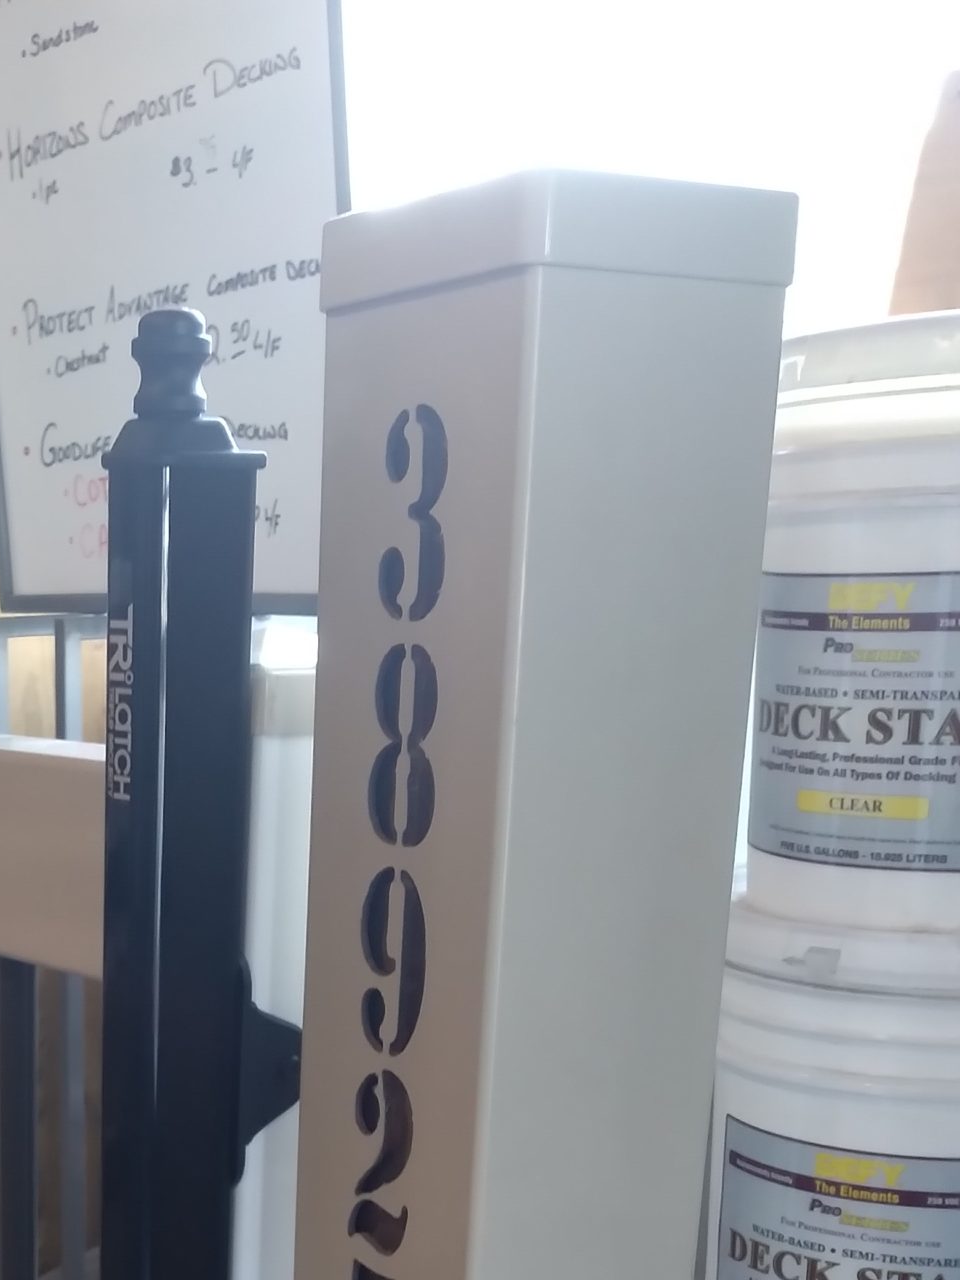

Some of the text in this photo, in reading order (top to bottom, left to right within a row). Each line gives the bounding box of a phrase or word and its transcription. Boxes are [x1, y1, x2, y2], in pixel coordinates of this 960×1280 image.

[22, 298, 96, 345] PROTECT
[828, 615, 910, 630] The Elements
[853, 689, 960, 701] SEMI-TRANSPA
[759, 698, 960, 746] DECK STA
[832, 752, 904, 766] Professional
[850, 769, 882, 782] Types
[886, 770, 900, 780] Of
[904, 771, 956, 784] Decking
[829, 797, 883, 813] CLEAR
[815, 1180, 900, 1204] The Elements
[752, 1224, 826, 1253] WATER-BASED
